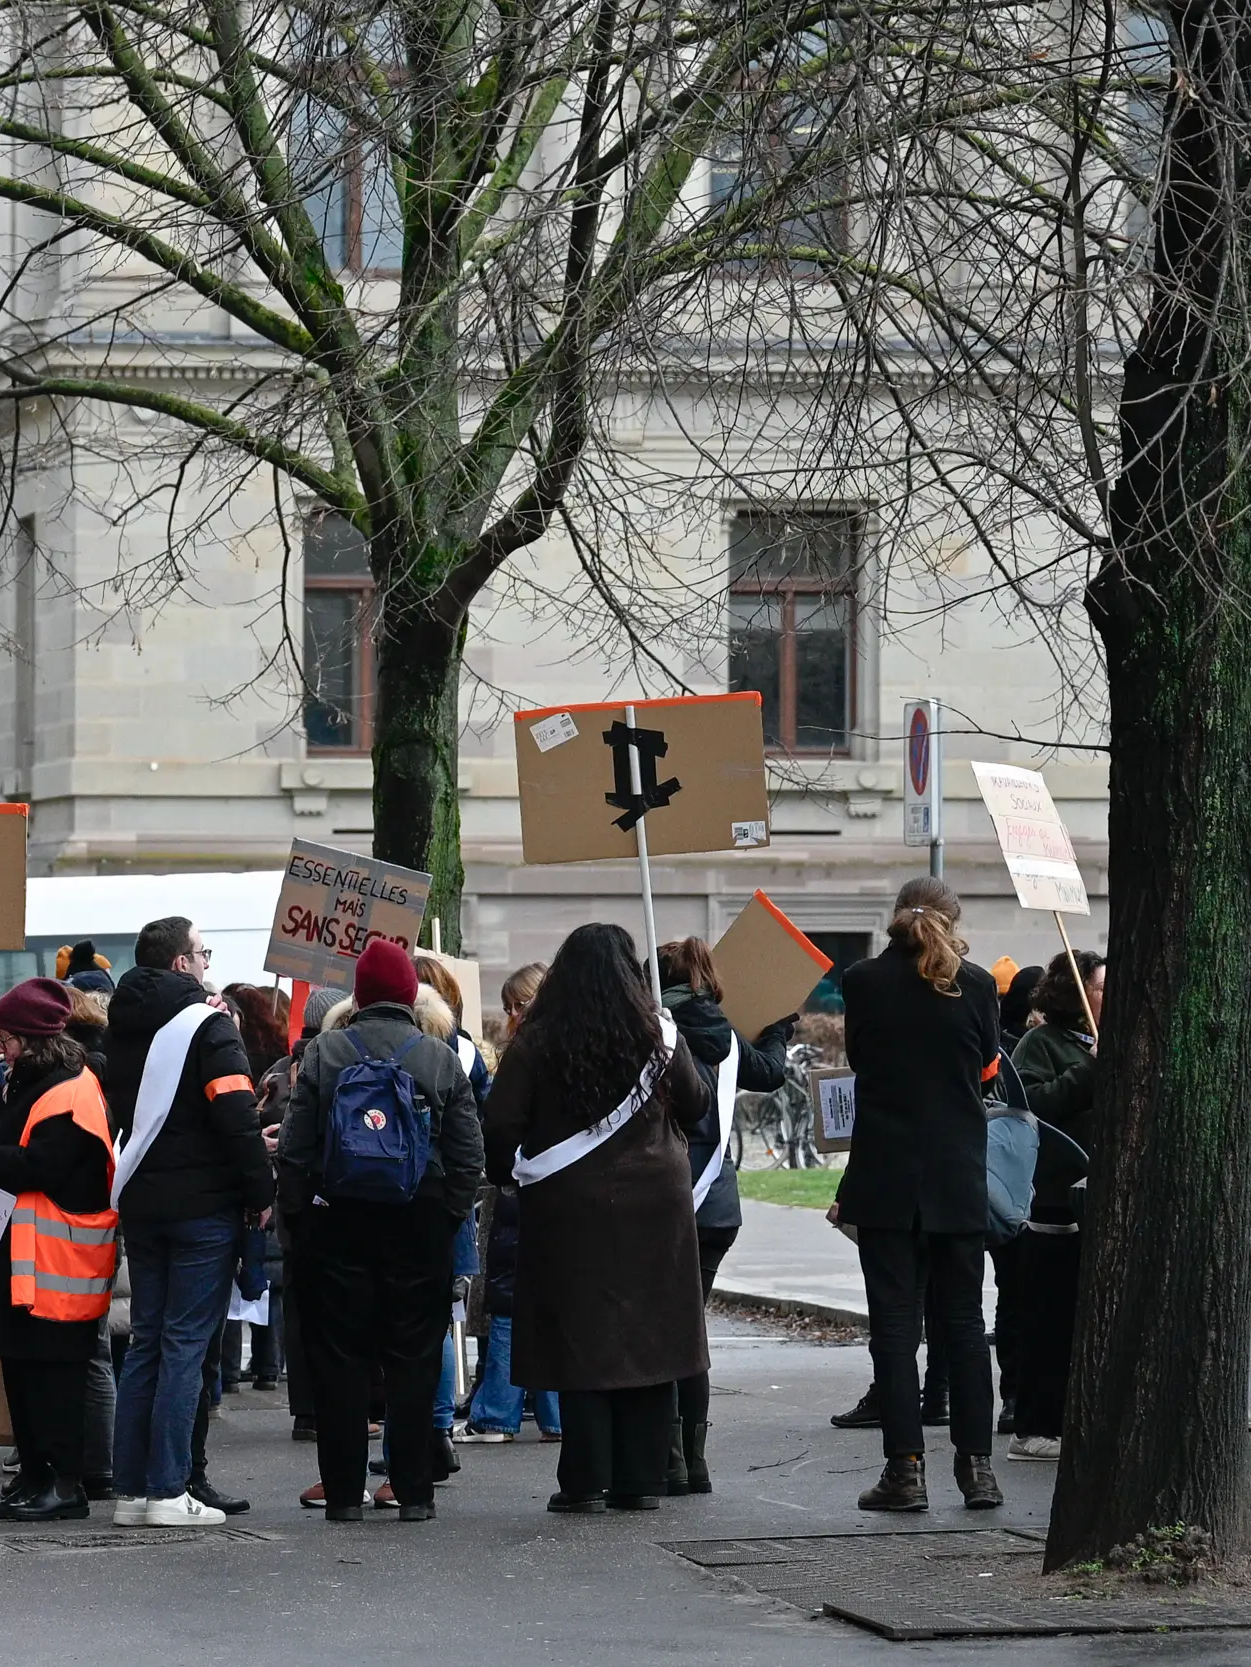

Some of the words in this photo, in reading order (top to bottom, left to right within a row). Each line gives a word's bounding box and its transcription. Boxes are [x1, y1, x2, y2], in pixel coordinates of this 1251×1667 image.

[288, 856, 408, 905] ESSENTIELLES
[281, 905, 340, 947] SANS
[337, 922, 409, 955] SEG
